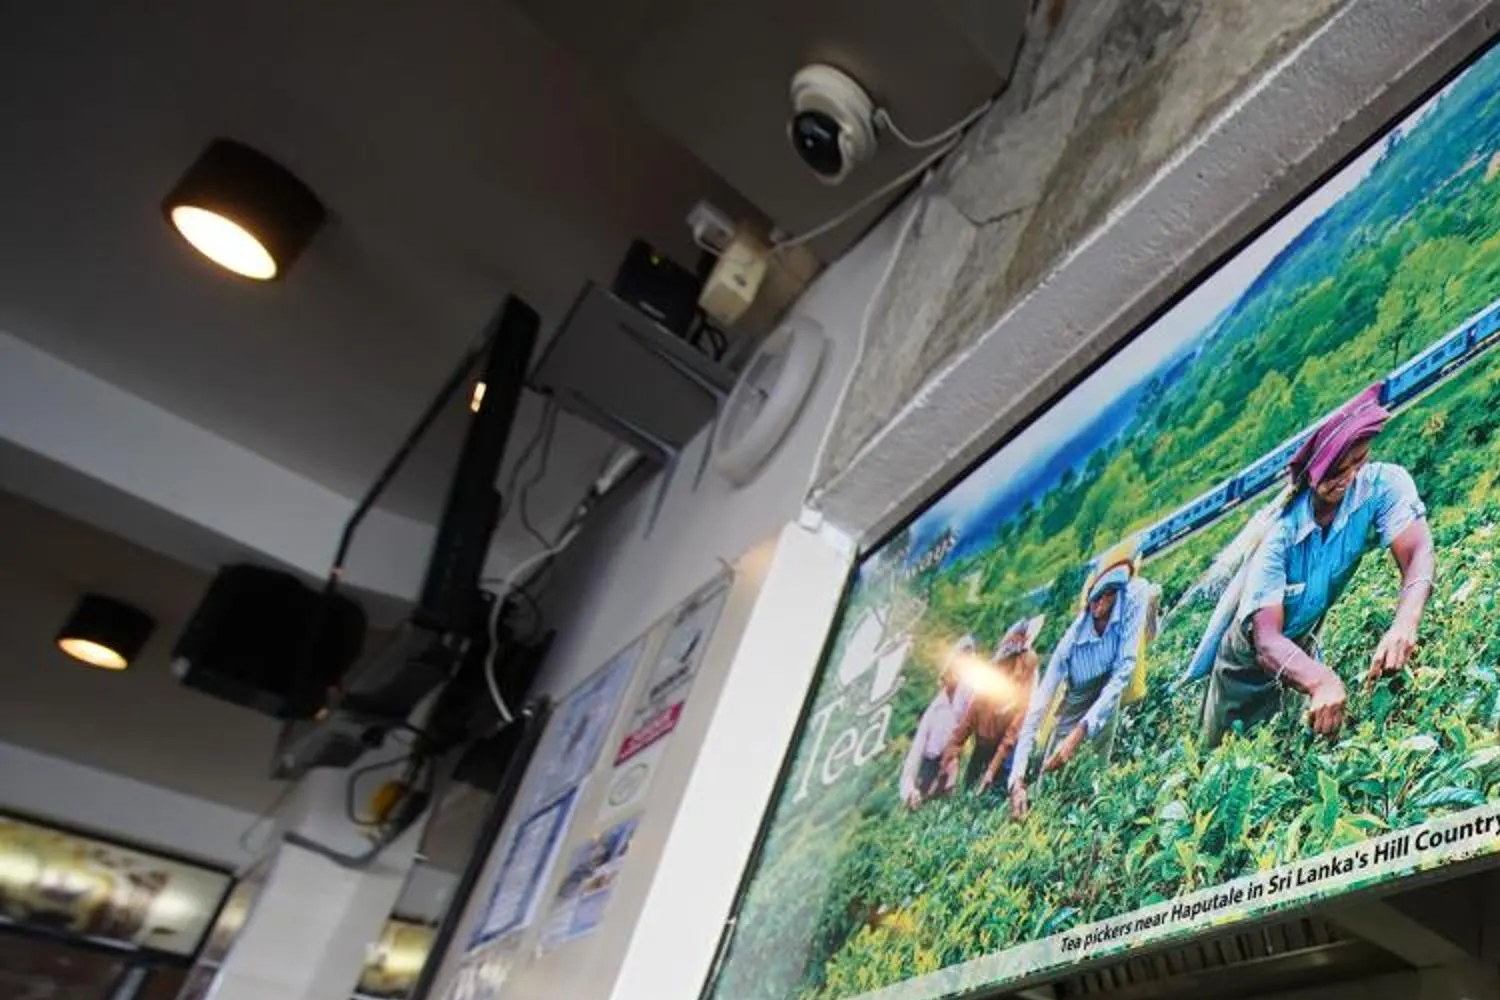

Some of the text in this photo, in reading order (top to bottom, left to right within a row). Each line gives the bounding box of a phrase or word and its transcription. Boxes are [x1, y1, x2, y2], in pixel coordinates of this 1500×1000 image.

[794, 696, 892, 801] Tea
[1060, 937, 1083, 953] Tea
[1083, 923, 1132, 949] pickers
[1134, 912, 1168, 932] near
[1171, 886, 1243, 920] Haputale
[1247, 881, 1263, 899] in
[1268, 870, 1293, 894] Sri
[1296, 850, 1368, 886] Lanka's
[1374, 836, 1410, 865] Hill
